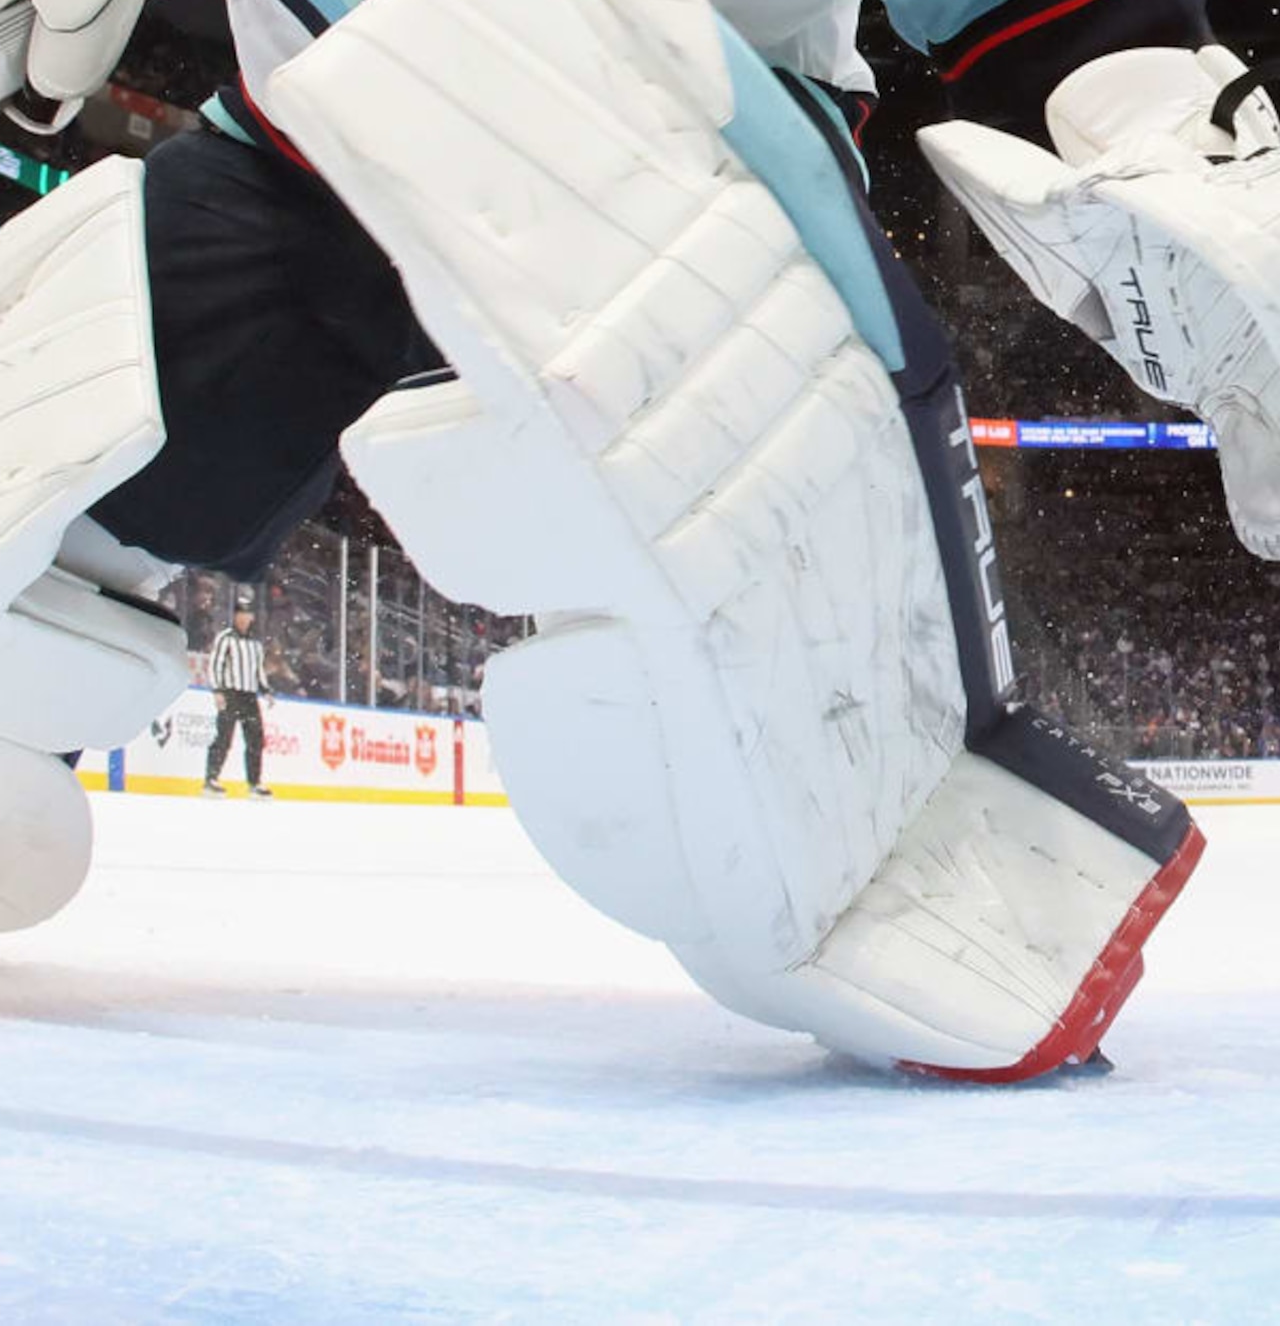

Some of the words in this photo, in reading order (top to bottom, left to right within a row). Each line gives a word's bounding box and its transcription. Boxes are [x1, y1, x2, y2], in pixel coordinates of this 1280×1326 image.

[1120, 265, 1167, 393] TRUE
[948, 383, 1015, 695] TRUE
[1150, 766, 1254, 781] NATIONWIDE
